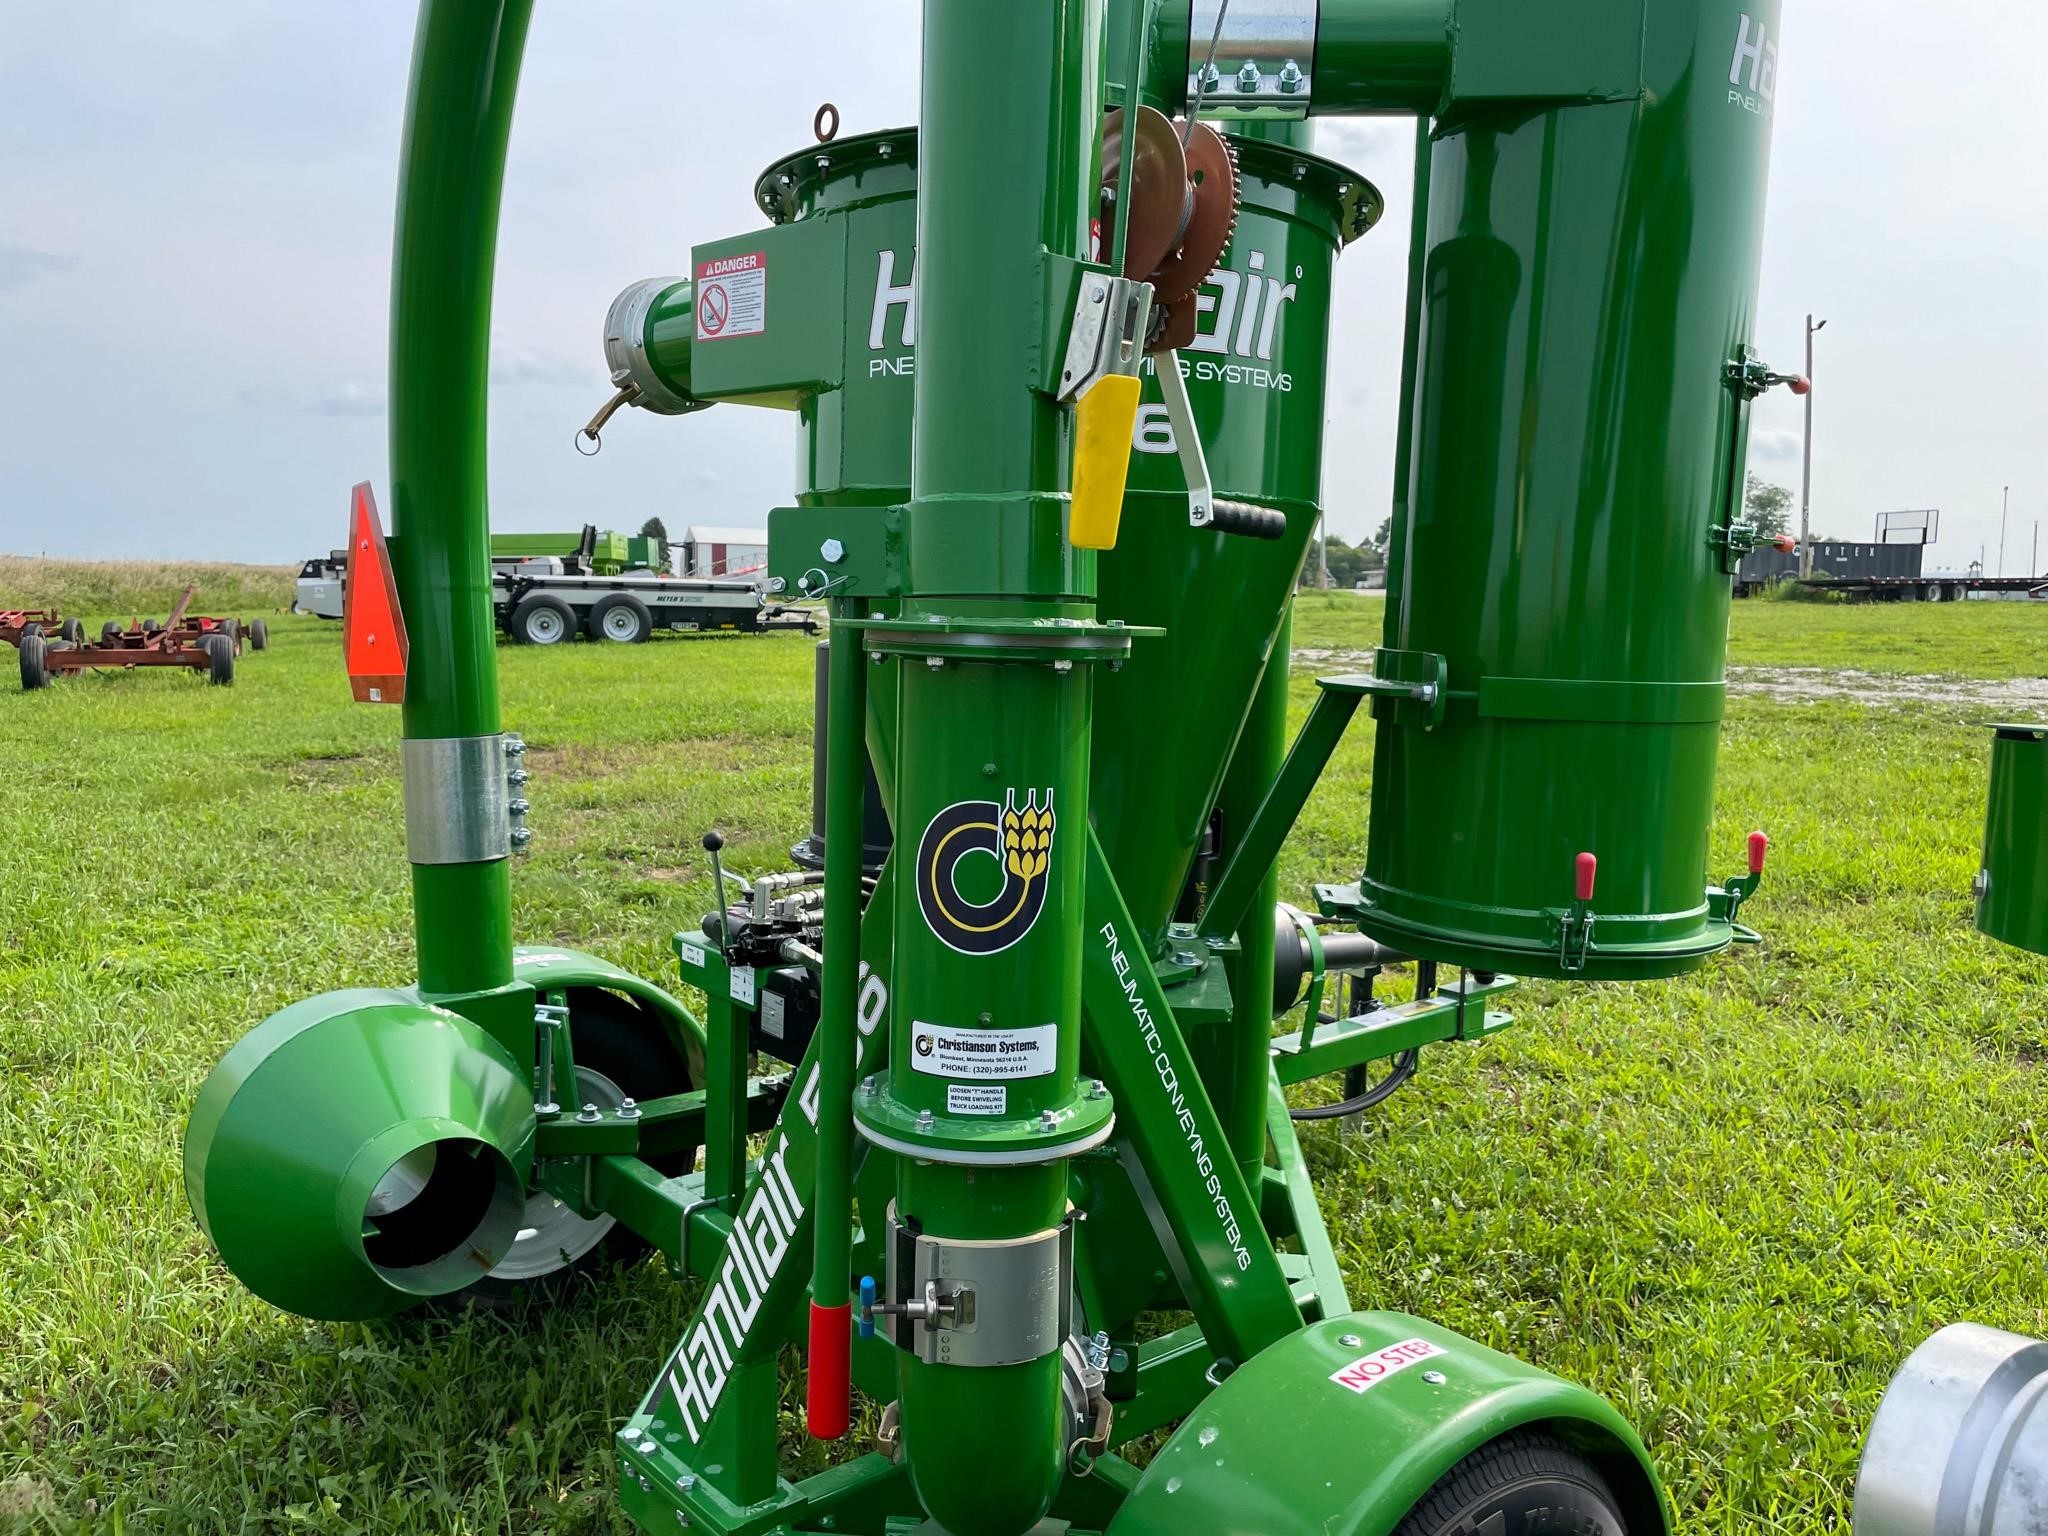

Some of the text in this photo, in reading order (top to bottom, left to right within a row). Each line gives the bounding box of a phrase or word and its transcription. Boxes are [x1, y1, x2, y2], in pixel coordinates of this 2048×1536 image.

[714, 254, 757, 274] DANGER
[1196, 361, 1292, 391] SYSTEMS
[938, 1037, 1039, 1055] Christianson Systems,
[941, 1063, 1027, 1074] PHONE: (320)-995-6141
[1099, 921, 1252, 1272] PNEUMATIC CONVEYING SYSTEMS
[668, 1131, 805, 1445] Handlair
[1338, 1341, 1435, 1388] NO STEP
